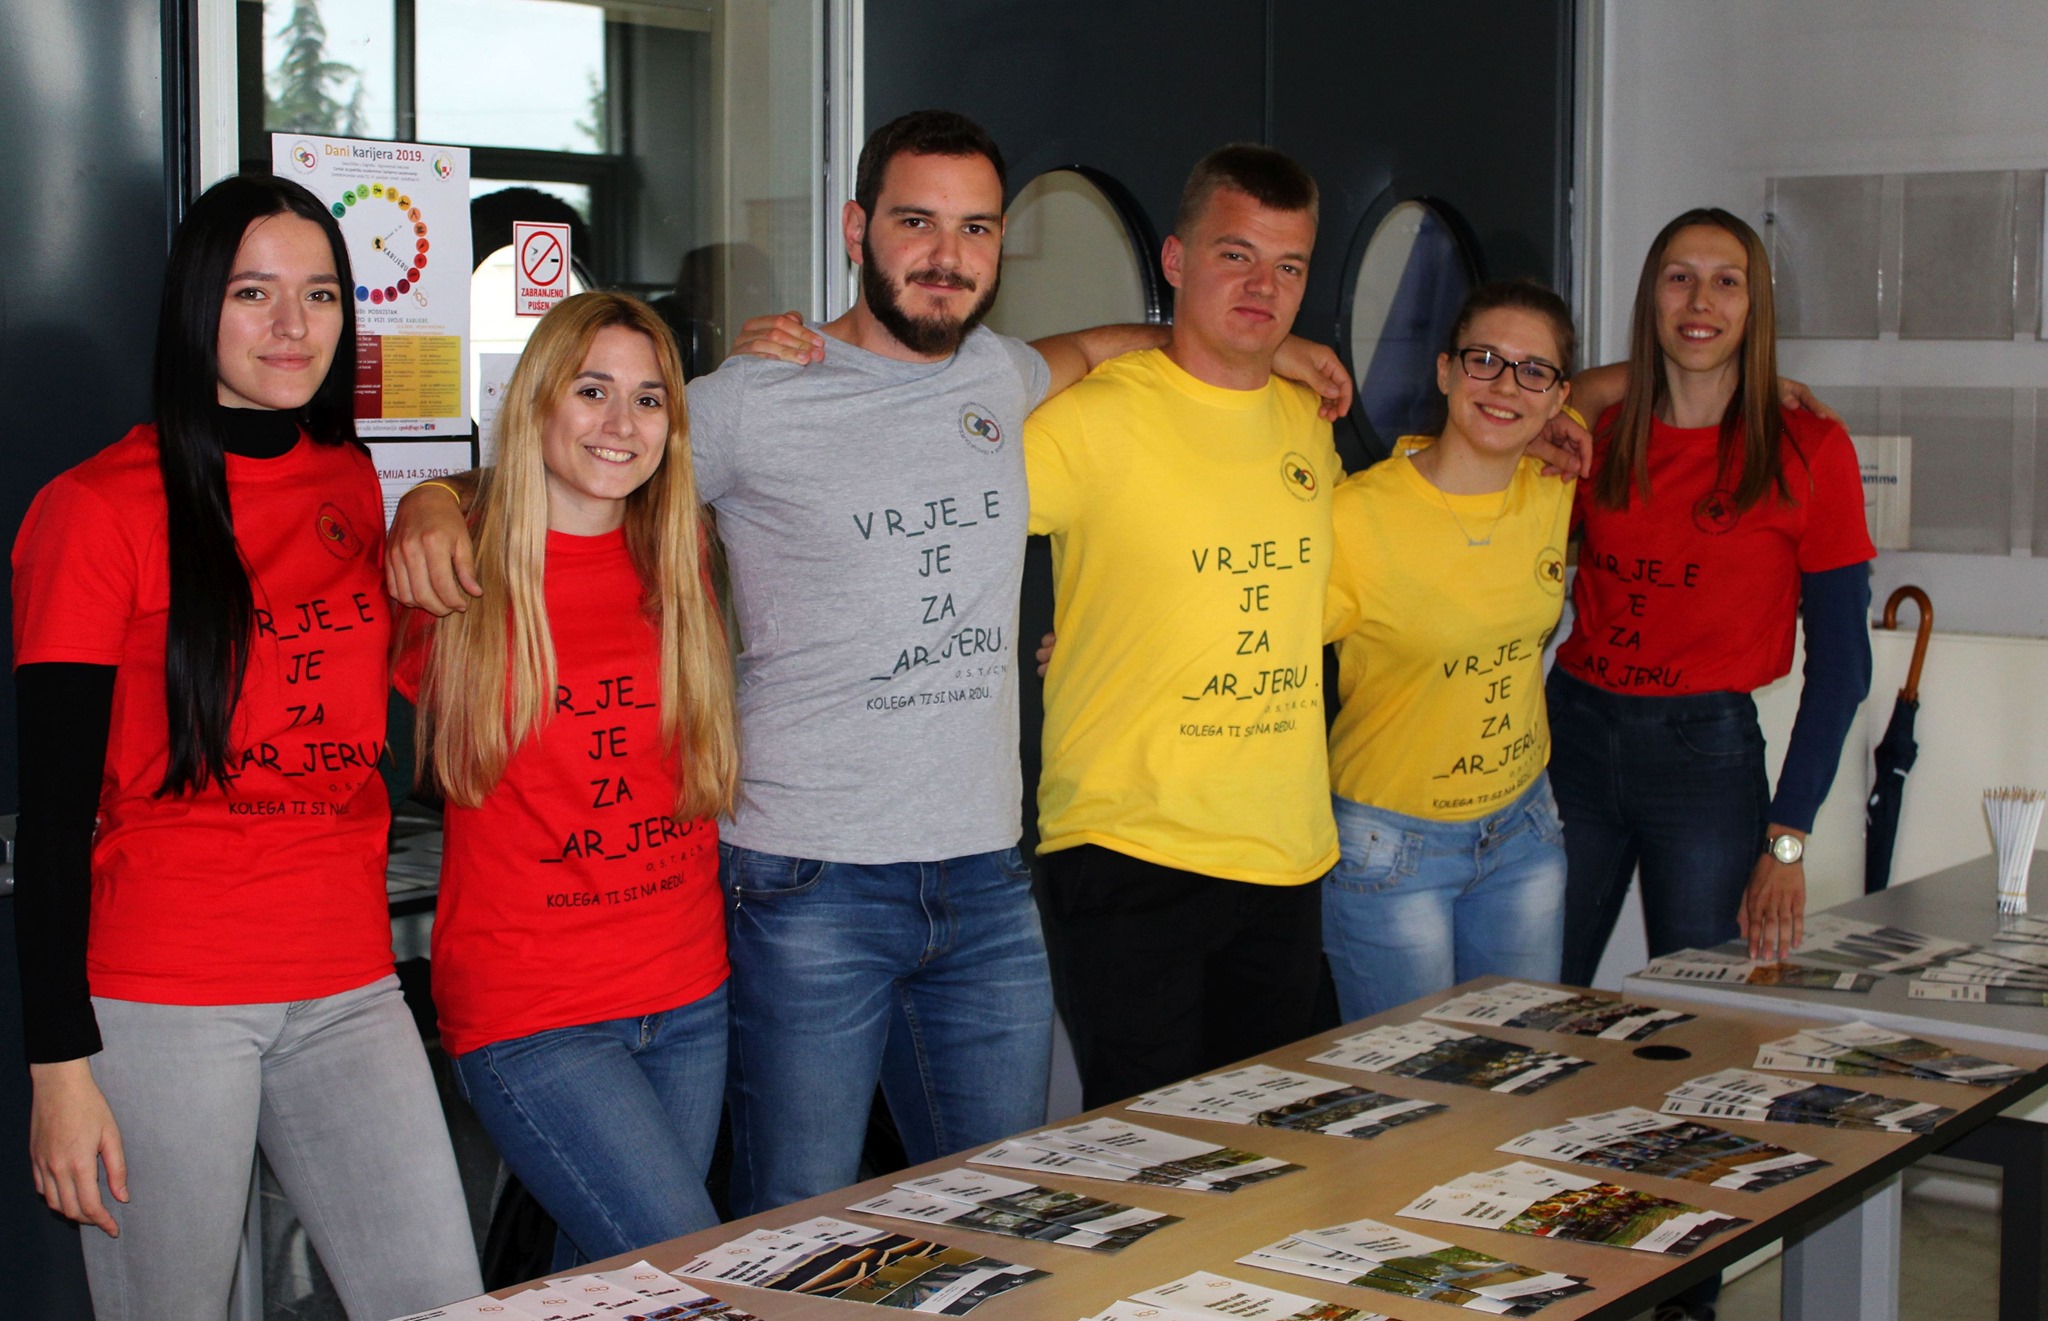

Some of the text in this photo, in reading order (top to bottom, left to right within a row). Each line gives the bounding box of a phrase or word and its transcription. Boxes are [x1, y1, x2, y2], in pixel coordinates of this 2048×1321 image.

[325, 143, 425, 162] Dani karijera 2019.
[382, 247, 409, 272] KARIJERU
[521, 288, 564, 298] ZABRANJENO
[528, 301, 558, 311] PUŠEN
[378, 469, 404, 479] EMIJA
[1862, 474, 1898, 485] amme
[918, 544, 951, 577] JE
[921, 593, 956, 624] ZA
[1240, 585, 1269, 613] JE
[1236, 630, 1270, 655] ZA
[1608, 625, 1641, 650] ZA
[286, 650, 324, 685] JE
[866, 695, 915, 711] KOLEGA
[920, 693, 933, 705] TI
[933, 691, 945, 704] SI
[948, 690, 966, 703] NA
[1485, 676, 1512, 704] JE
[1180, 724, 1223, 737] KOLEGA
[1228, 725, 1241, 738] TI
[1256, 723, 1271, 734] NA
[1481, 713, 1511, 739] ZA
[588, 726, 628, 760] JE
[590, 776, 633, 809] ZA
[1433, 798, 1473, 809] KOLEGA
[229, 801, 286, 815] KOLEGA
[291, 800, 306, 815] TI
[311, 801, 326, 815] SI
[546, 892, 600, 908] KOLEGA
[604, 891, 620, 905] TI
[623, 886, 637, 902] SI
[640, 882, 657, 897] NA
